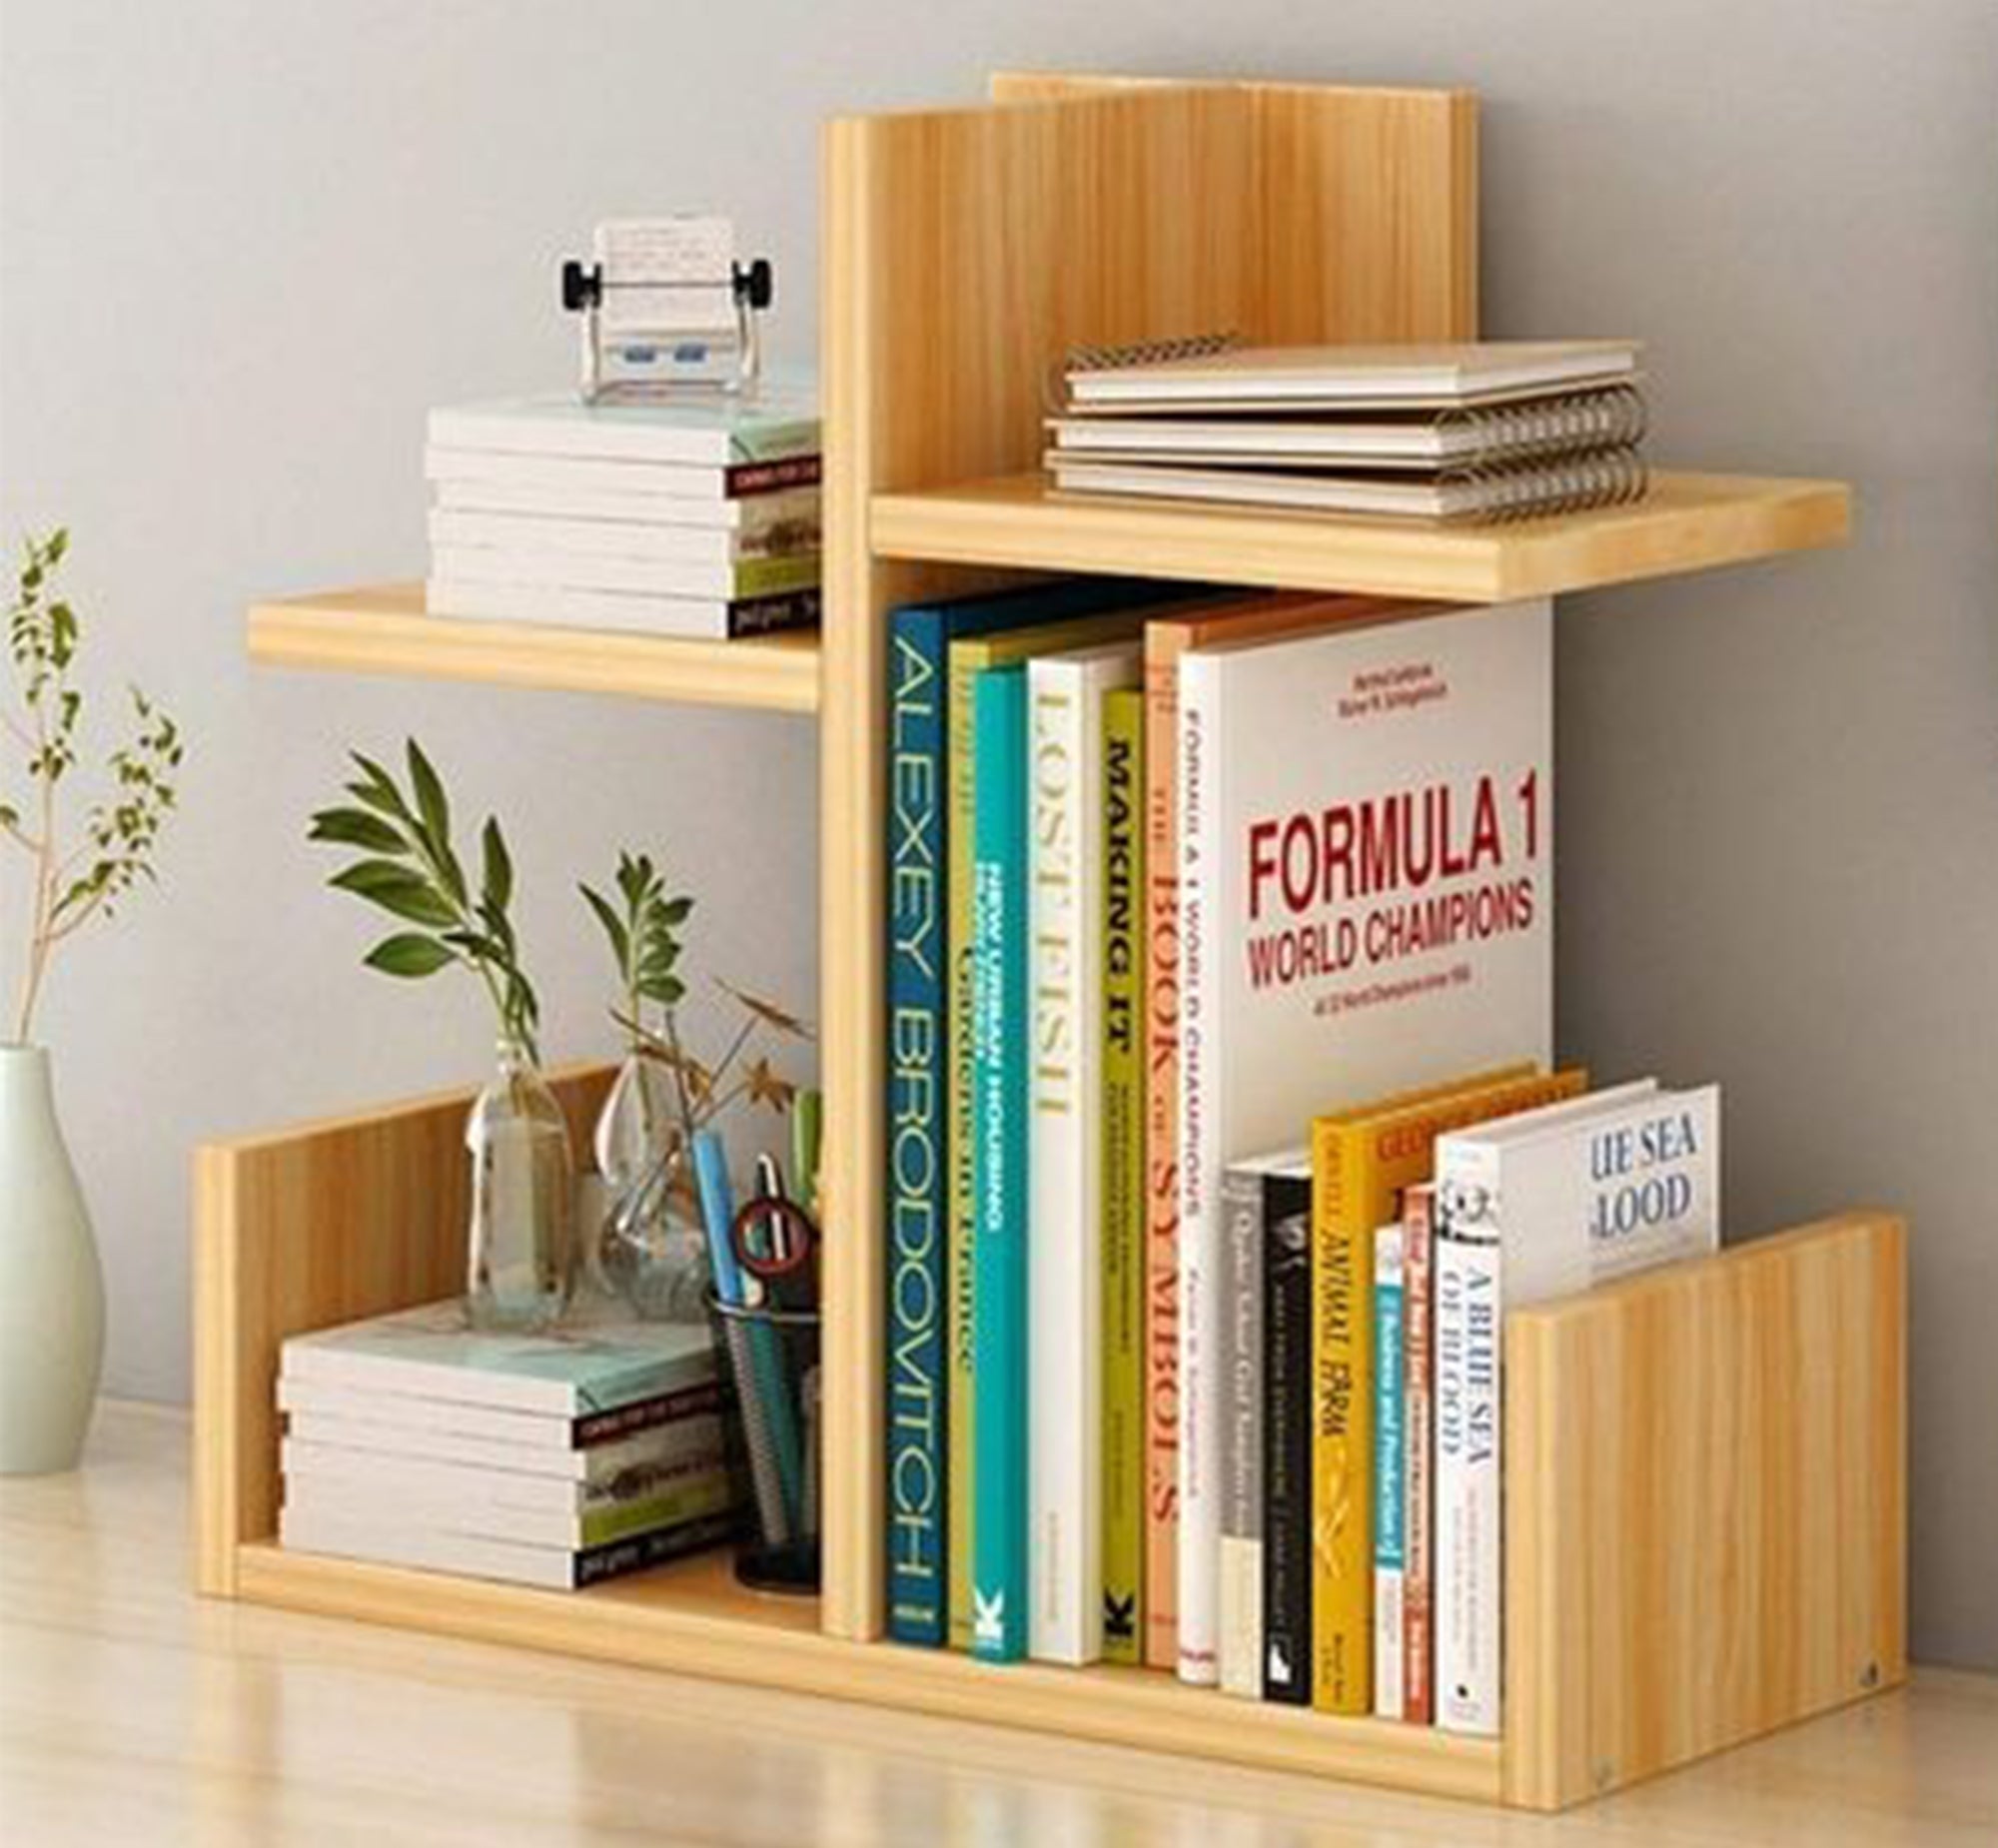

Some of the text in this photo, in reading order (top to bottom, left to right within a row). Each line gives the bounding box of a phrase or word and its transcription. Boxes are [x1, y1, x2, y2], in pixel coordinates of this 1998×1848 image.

[894, 636, 934, 978] ALEXEY
[1185, 709, 1201, 865] FORMULA
[1249, 768, 1537, 920] FORMULA 1
[1037, 693, 1069, 1117] LOST FISH
[1108, 740, 1132, 976] MAKING
[1152, 875, 1179, 1074] BOOK
[1185, 900, 1201, 1017] WORLD
[1248, 919, 1358, 990] WORLD
[1364, 878, 1534, 965] CHAMPIONS
[986, 863, 1003, 1232] NEW URBAN HOUSING
[1108, 995, 1132, 1054] IT
[1185, 1027, 1201, 1217] CHAMPIONS
[1639, 1109, 1697, 1167] SEA
[1589, 1173, 1691, 1239] LOOD
[894, 1008, 936, 1577] BRODOVITCH
[1152, 1161, 1179, 1523] SYMBOLS
[1320, 1230, 1352, 1348] ANIMAL
[1467, 1268, 1493, 1292] A
[1467, 1303, 1493, 1390] BLUE
[1320, 1360, 1352, 1438] FARM
[1382, 1395, 1401, 1427] and
[1442, 1270, 1463, 1456] OF BLOOD
[1467, 1401, 1493, 1465] SEA
